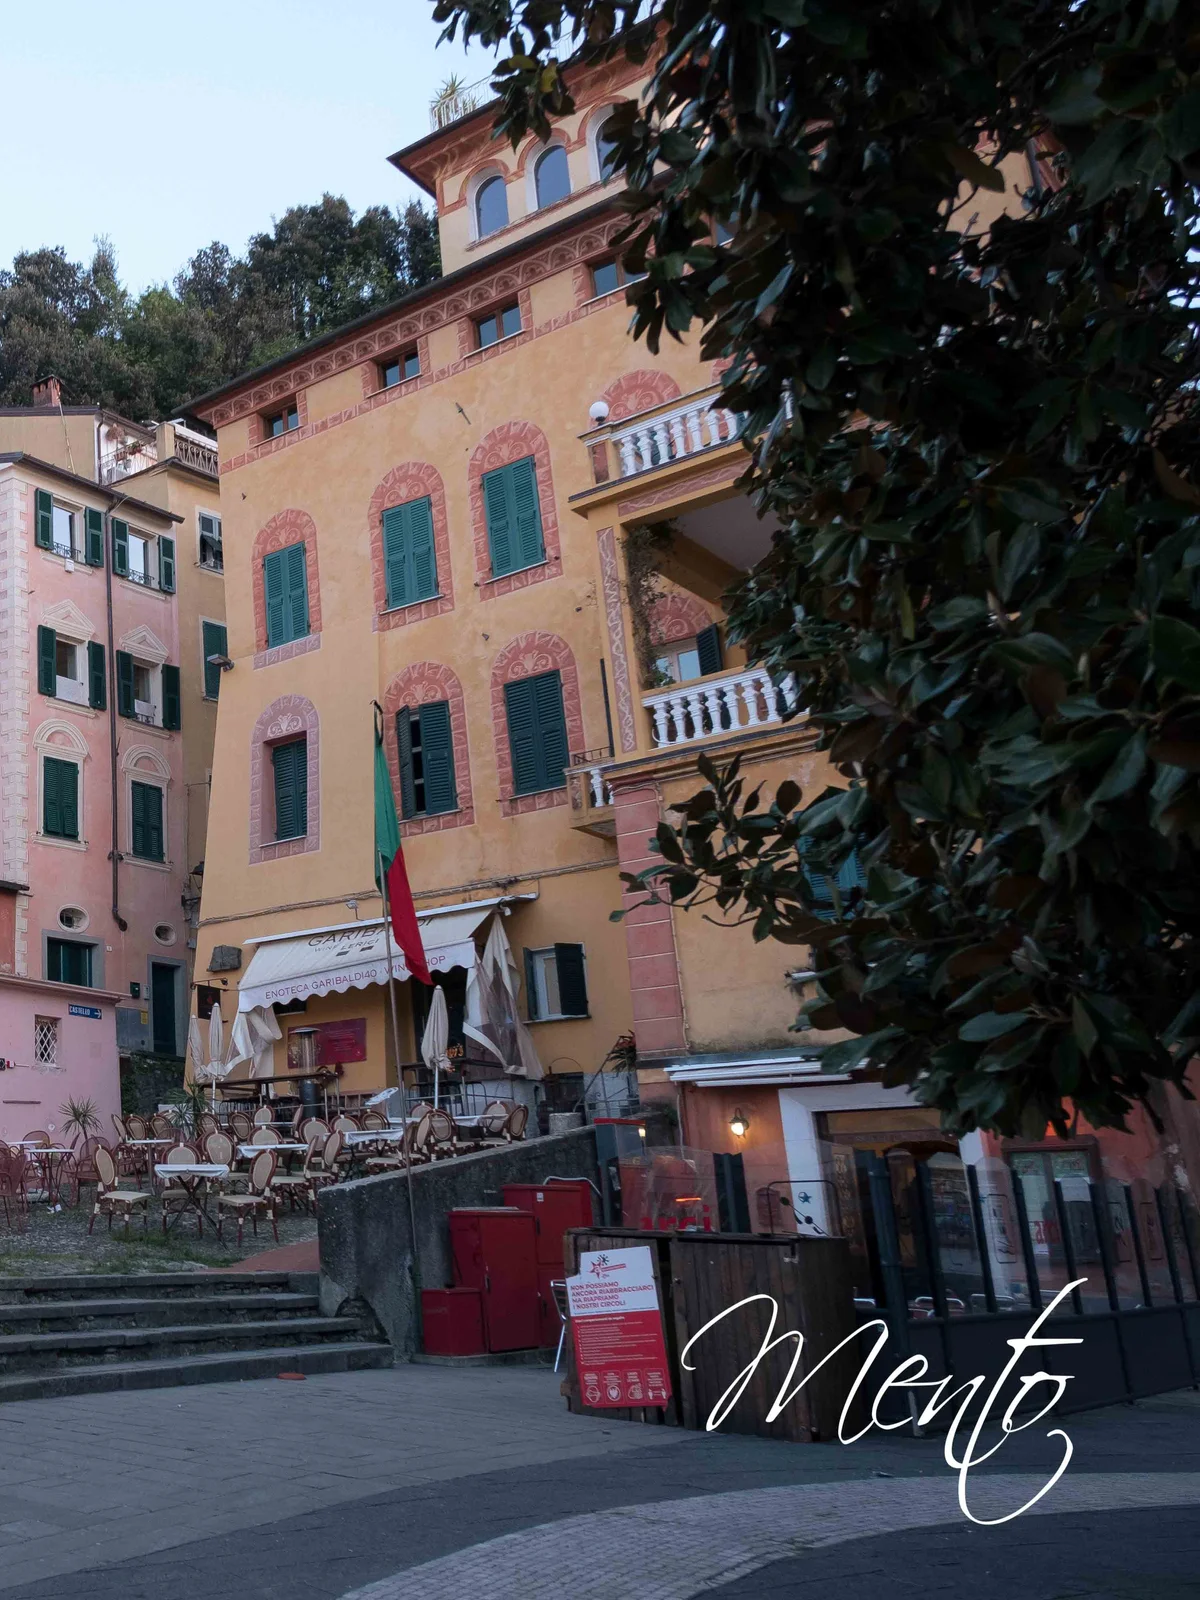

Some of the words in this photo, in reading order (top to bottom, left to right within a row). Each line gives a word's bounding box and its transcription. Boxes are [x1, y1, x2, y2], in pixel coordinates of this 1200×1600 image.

[340, 938, 380, 951] LERICI
[265, 983, 310, 1000] ENOTECA
[311, 969, 378, 990] GARIBALDI40
[383, 963, 407, 976] WIN
[69, 1005, 91, 1016] CASTELLO
[585, 1281, 619, 1290] POSSIAMO
[571, 1289, 598, 1297] ANCORA
[583, 1294, 620, 1303] RIAPRIAMO
[576, 1301, 600, 1310] NOSTRI
[600, 1299, 626, 1308] CIRCOLI
